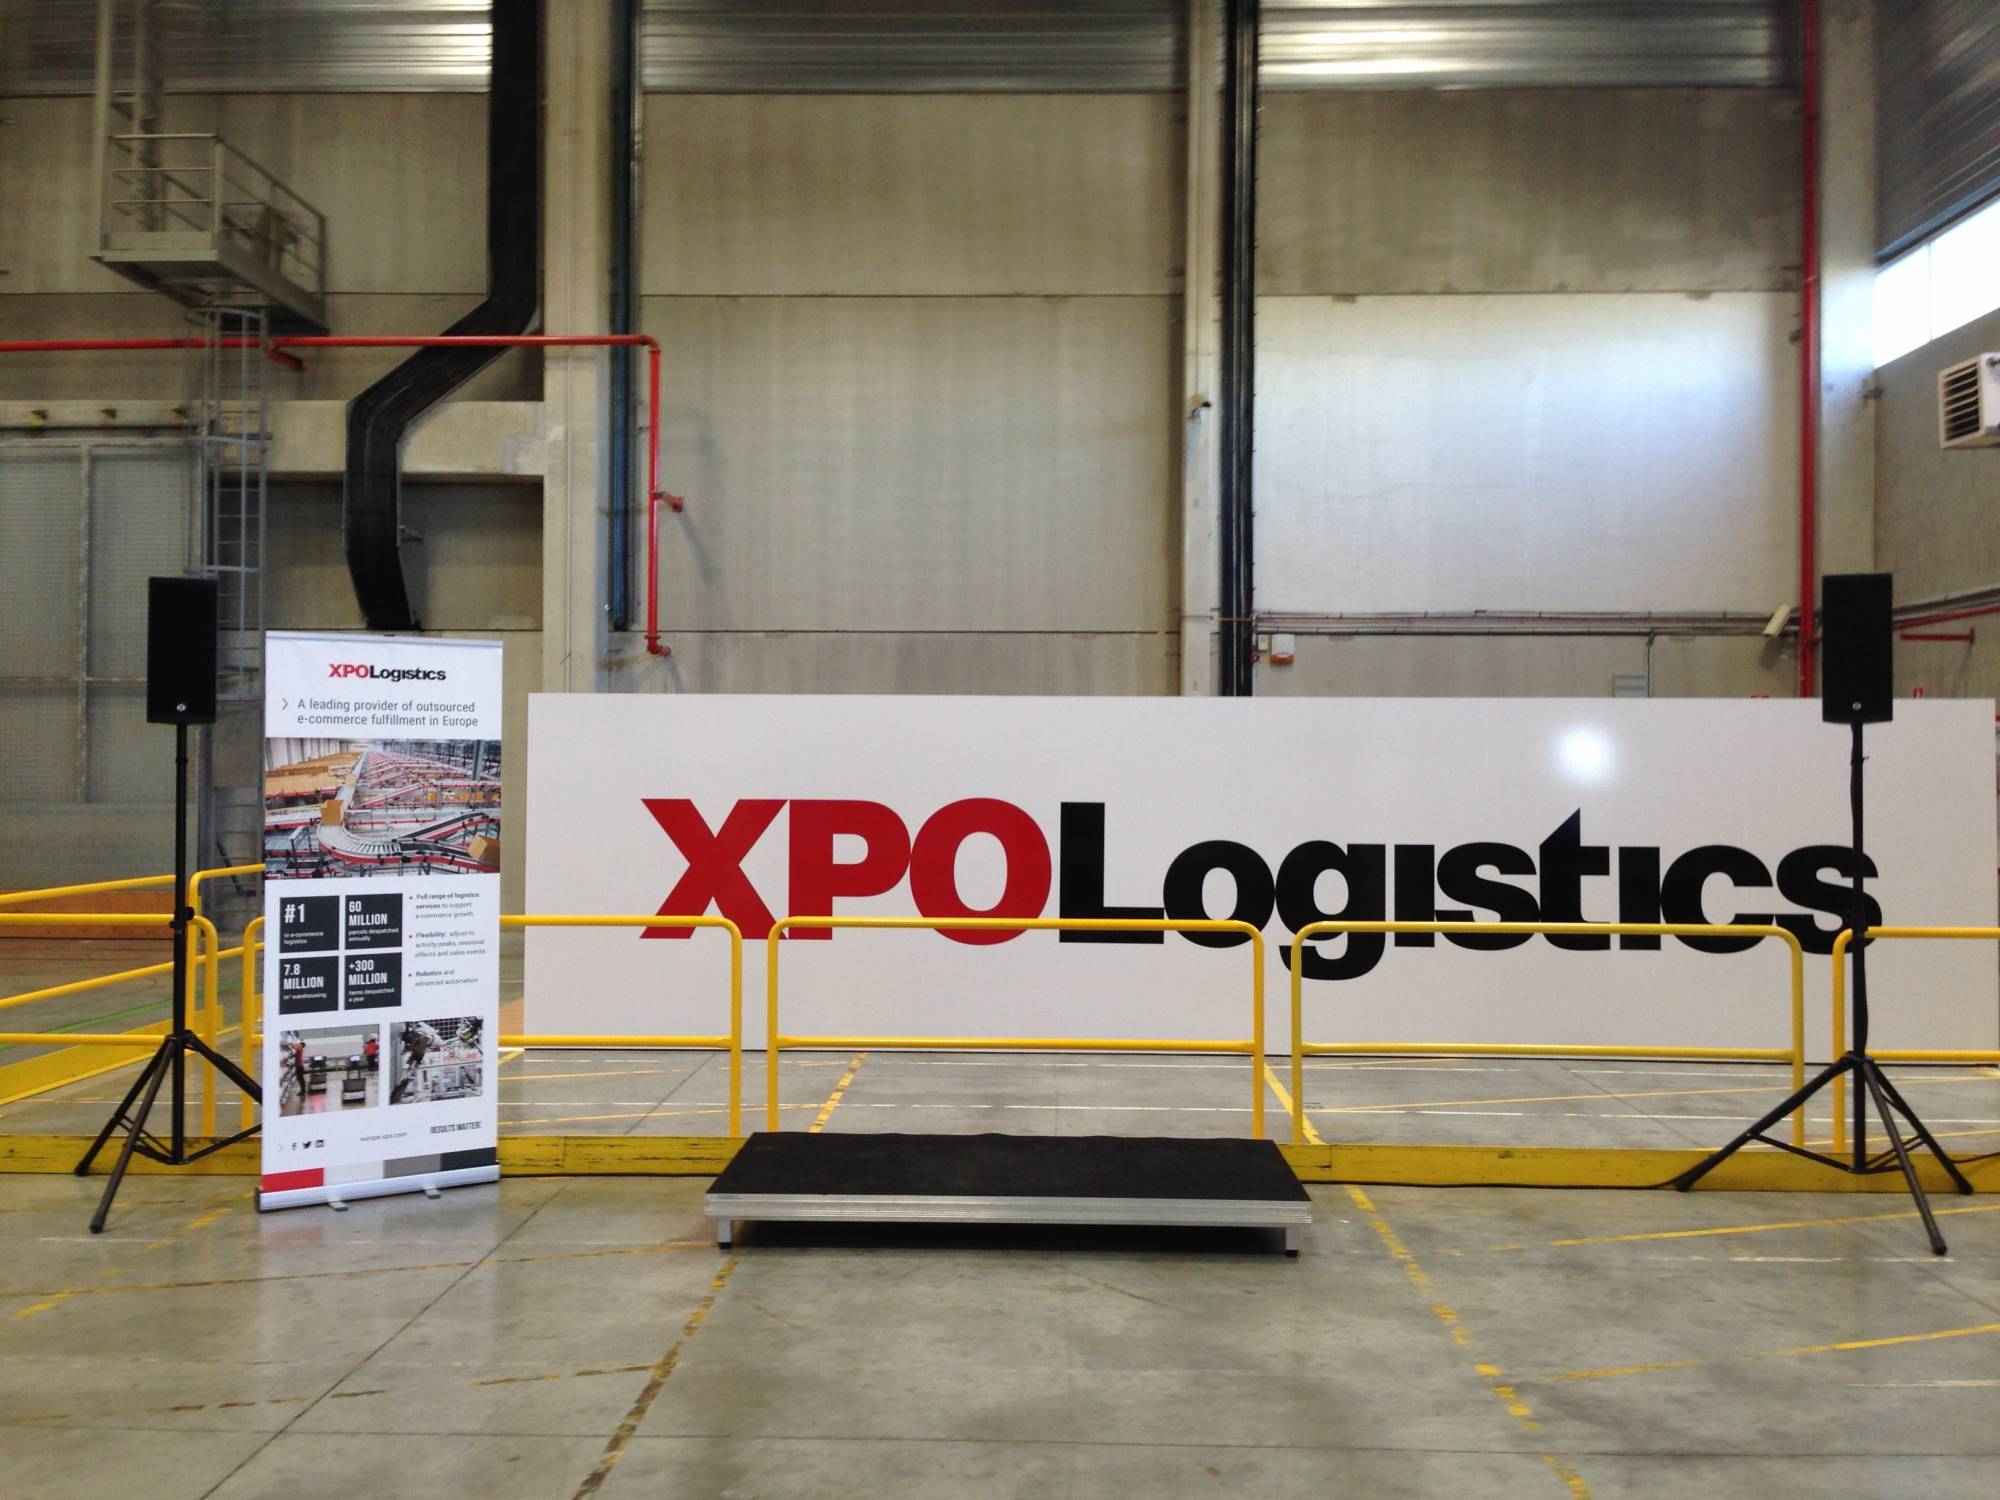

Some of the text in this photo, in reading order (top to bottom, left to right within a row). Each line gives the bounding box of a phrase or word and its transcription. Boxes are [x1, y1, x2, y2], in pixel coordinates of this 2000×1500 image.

[329, 664, 446, 682] XPOLogistics
[297, 699, 475, 713] A leading provider of outsourced
[297, 714, 478, 728] e-commerce fulfillment in Europe
[640, 797, 1880, 981] XPOLogistics
[284, 904, 305, 923] #1
[349, 901, 361, 912] 60
[348, 913, 388, 926] MILLION
[284, 963, 300, 976] 7.8
[348, 959, 374, 971] +300
[283, 976, 324, 990] MILLION
[348, 972, 387, 986] MILLION
